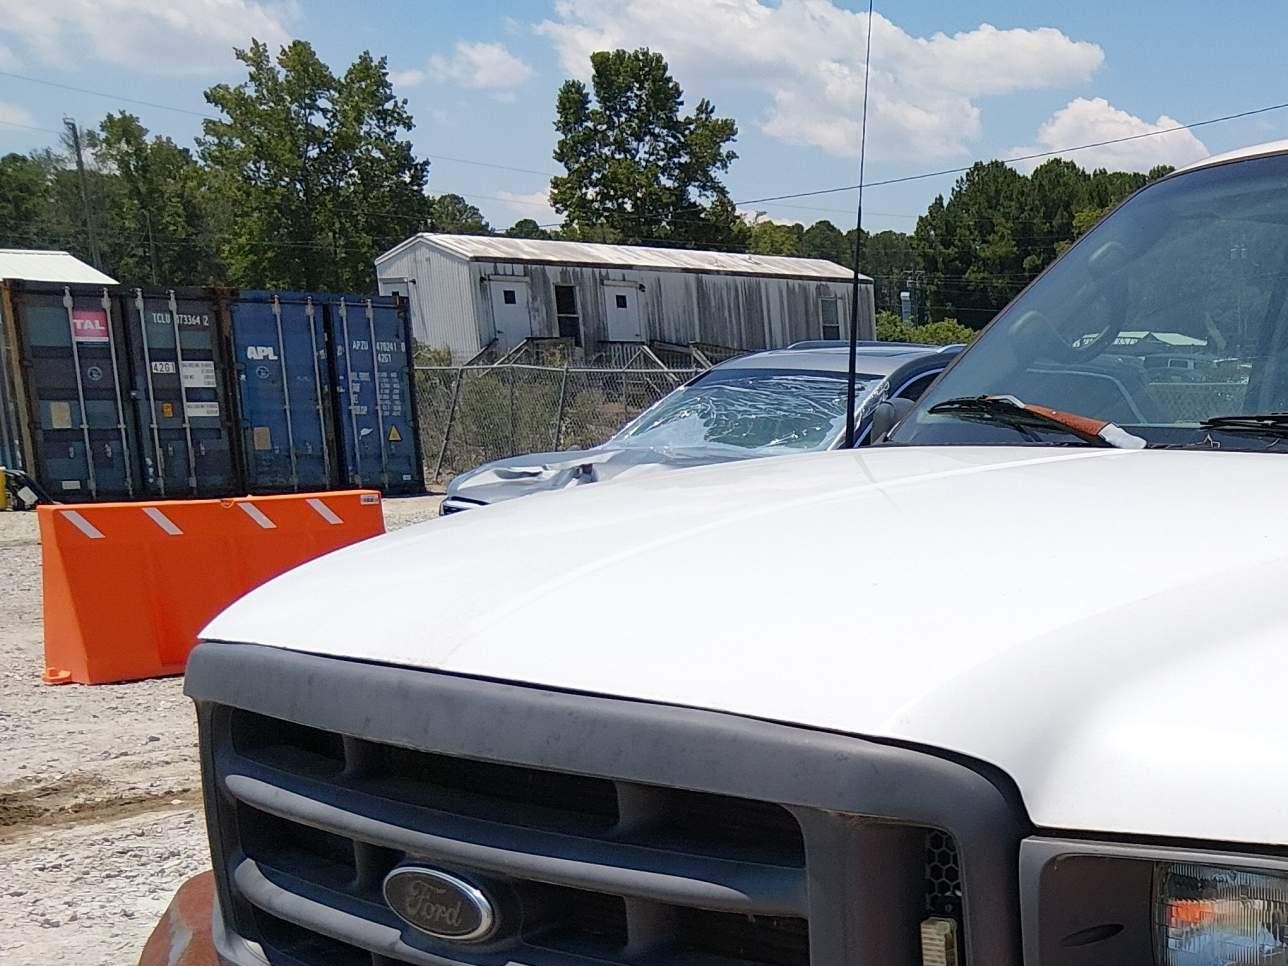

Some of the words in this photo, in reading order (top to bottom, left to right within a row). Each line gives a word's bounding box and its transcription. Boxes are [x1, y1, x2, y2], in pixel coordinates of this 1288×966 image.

[72, 319, 106, 330] TAL
[152, 312, 171, 324] TCLU
[247, 346, 279, 360] APL
[405, 879, 463, 927] Ford
